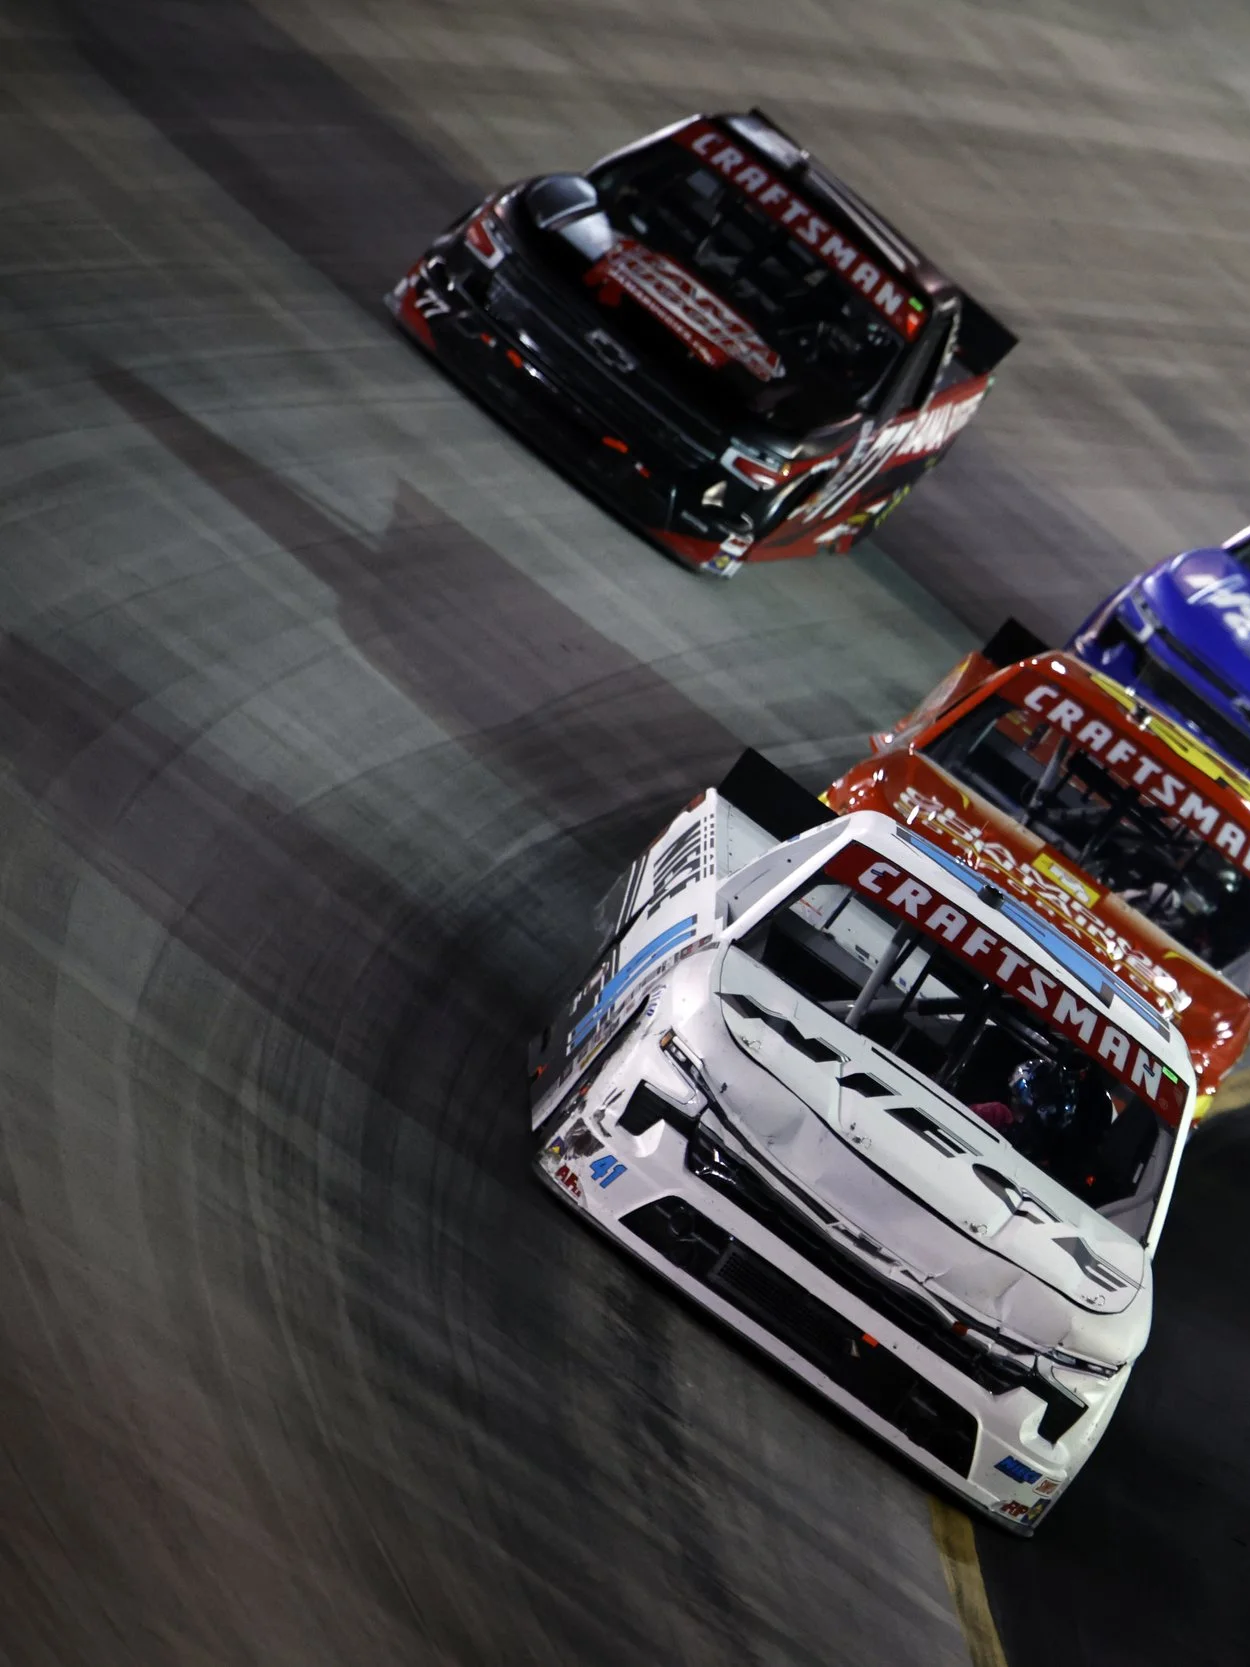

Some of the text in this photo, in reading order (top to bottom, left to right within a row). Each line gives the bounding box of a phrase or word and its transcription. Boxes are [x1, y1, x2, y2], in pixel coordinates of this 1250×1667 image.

[413, 287, 452, 319] 77
[692, 130, 904, 317] CRAFTSMAN
[857, 862, 1164, 1101] CRAFTSMAN
[589, 1154, 629, 1189] 41
[715, 990, 1142, 1293] NIECE
